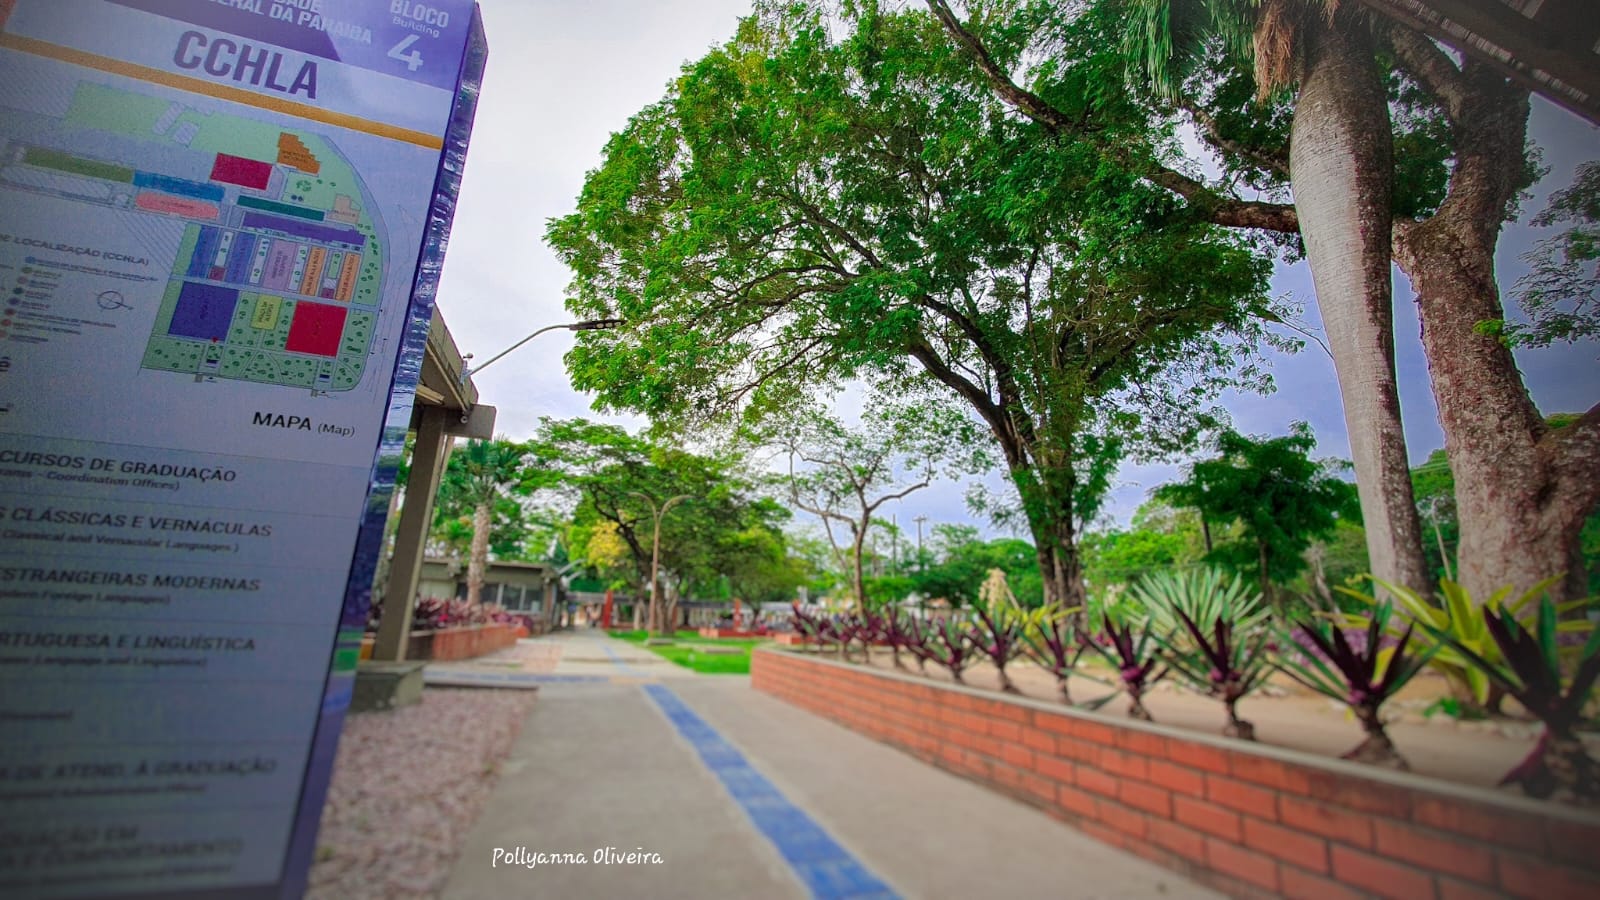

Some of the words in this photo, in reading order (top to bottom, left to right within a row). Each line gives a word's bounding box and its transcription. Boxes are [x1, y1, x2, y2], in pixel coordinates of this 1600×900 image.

[269, 3, 294, 23] DA
[273, 0, 321, 15] ADE
[390, 0, 449, 28] BLOCO
[392, 15, 440, 39] Building
[173, 30, 318, 100] CCHLA
[387, 33, 424, 72] 4
[252, 411, 311, 431] MAPA
[317, 423, 355, 438] (Map)
[0, 450, 86, 469] CURSOS
[89, 458, 116, 472] DE
[120, 460, 237, 483] GRADUAÇÃO
[12, 506, 127, 528] CLÁSSICAS
[131, 515, 145, 529] E
[149, 516, 273, 537] VERNÁCULAS
[153, 575, 262, 592] MODERNAS
